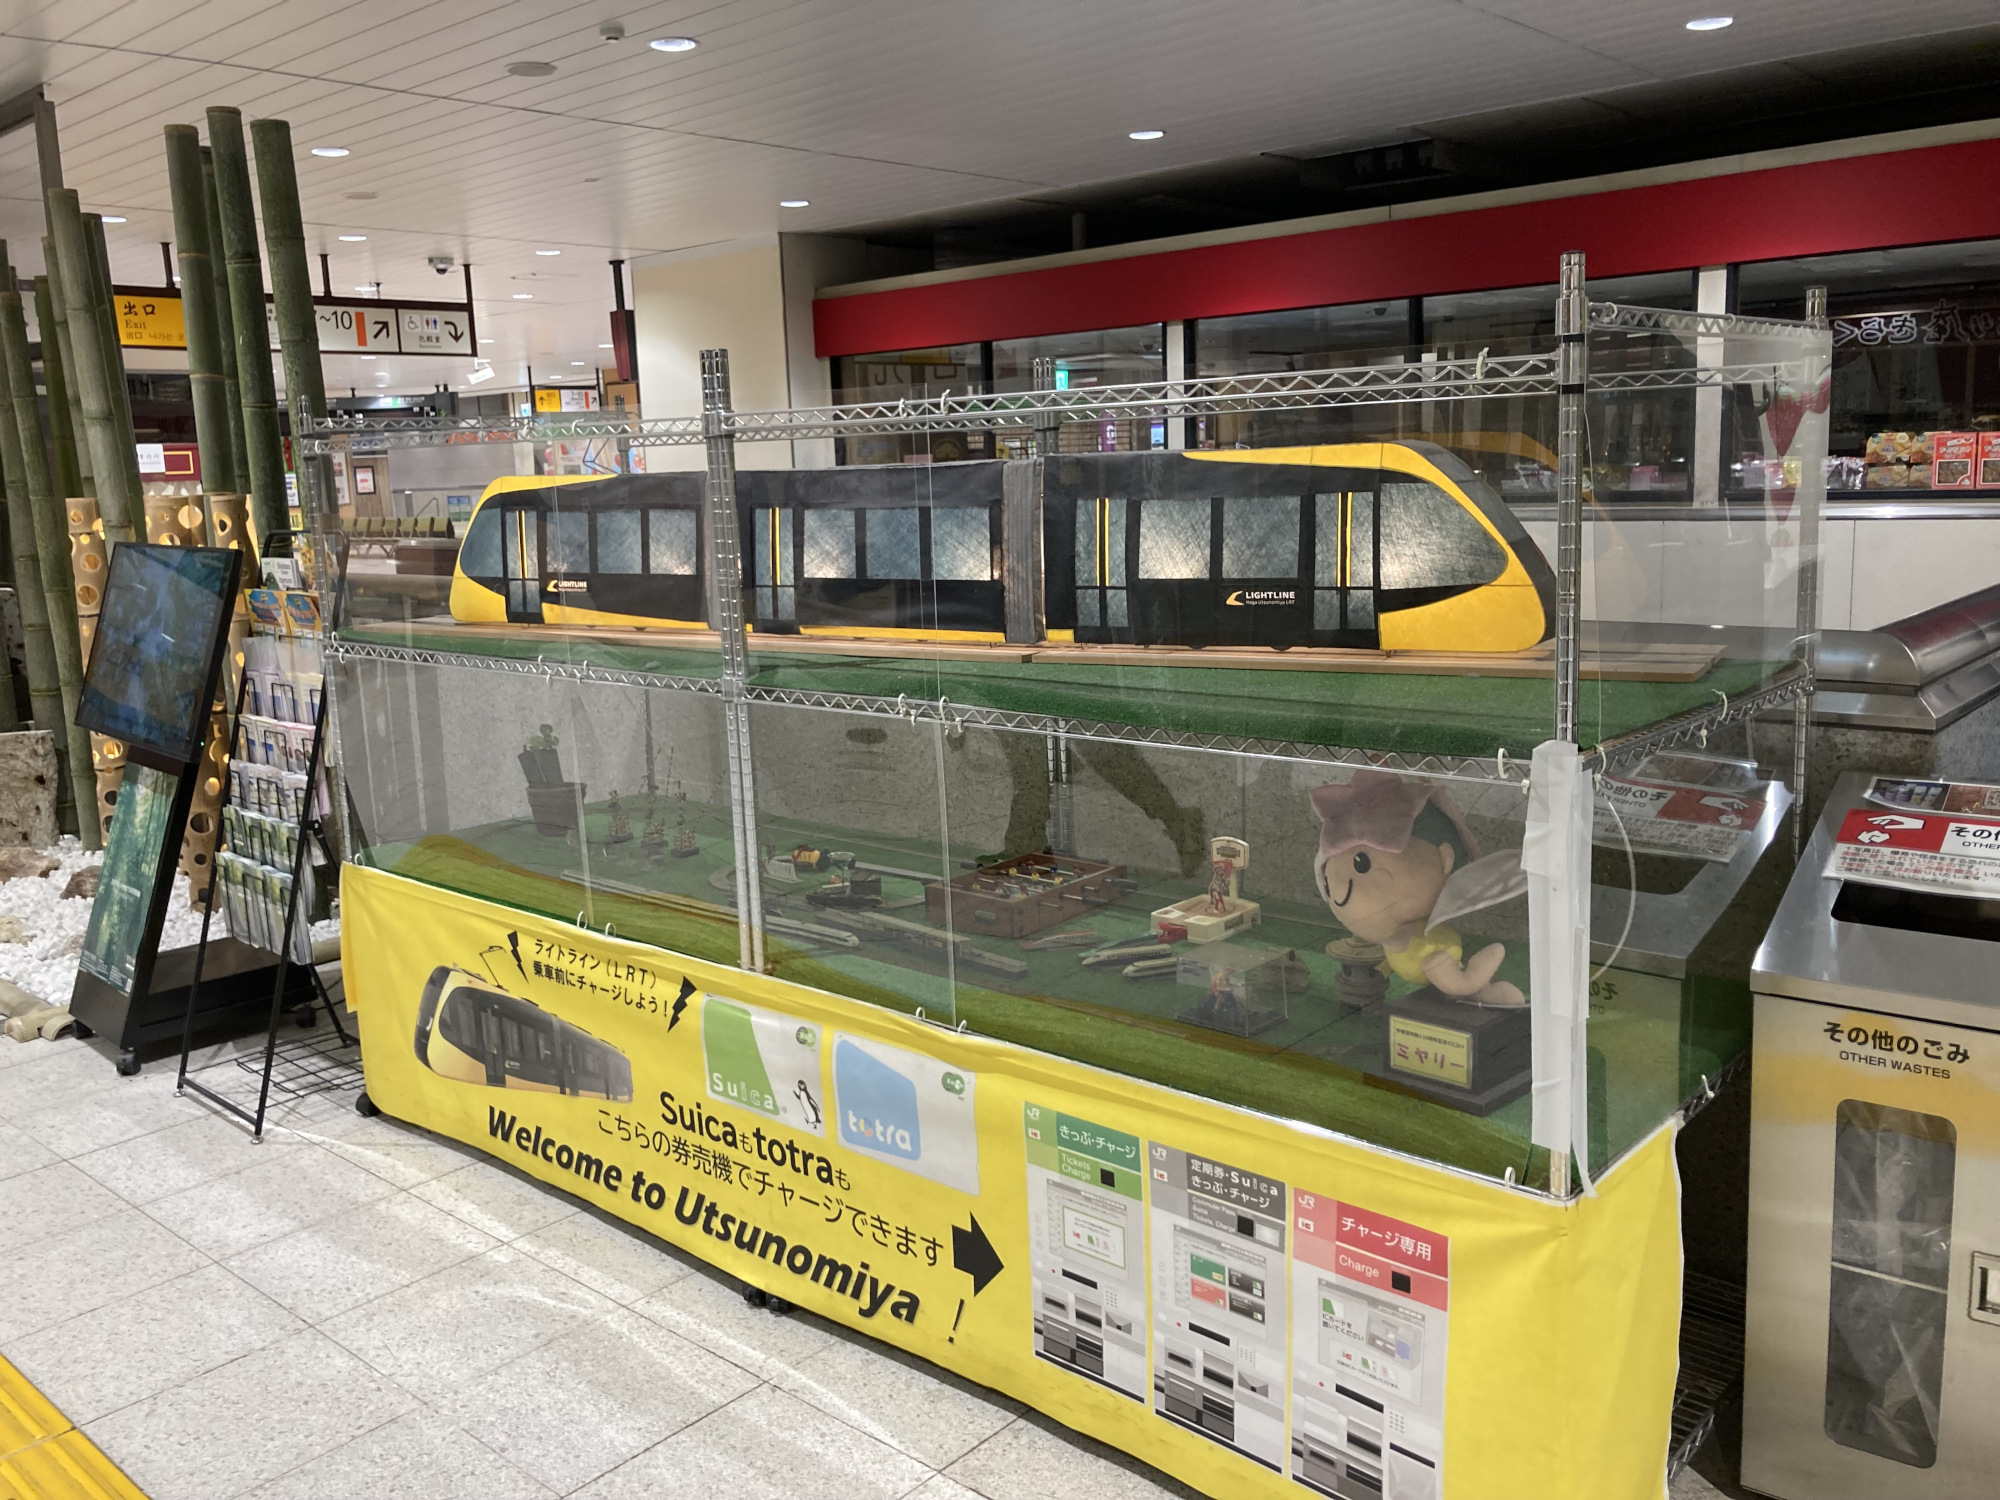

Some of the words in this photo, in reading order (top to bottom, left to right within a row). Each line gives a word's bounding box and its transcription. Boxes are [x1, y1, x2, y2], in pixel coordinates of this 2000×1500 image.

[123, 301, 156, 316] 出口
[314, 310, 353, 330] ~10
[125, 319, 147, 330] Exit
[558, 580, 588, 588] LIGHTLINE
[1245, 591, 1296, 599] LIGHTLINE
[1397, 1042, 1465, 1070] ミヤリー
[1823, 1021, 1970, 1064] その他のごみ
[1839, 1050, 1887, 1068] OTHER
[1891, 1060, 1951, 1080] WASTES
[712, 1072, 774, 1111] Suica
[848, 1109, 913, 1152] totra
[1058, 1124, 1136, 1159] きっぷ・チャージ
[1062, 1152, 1091, 1171] Tickets
[1062, 1163, 1091, 1181] Charge
[598, 1108, 945, 1267] こちらの券売機でチャージできます
[1191, 1174, 1271, 1208] きっぷ・チャージ
[488, 1104, 623, 1192] Welcome
[631, 1170, 666, 1210] to
[674, 1185, 921, 1325] Utsunomiya
[1341, 1216, 1432, 1262] チャージ専用
[1339, 1253, 1380, 1278] Charge
